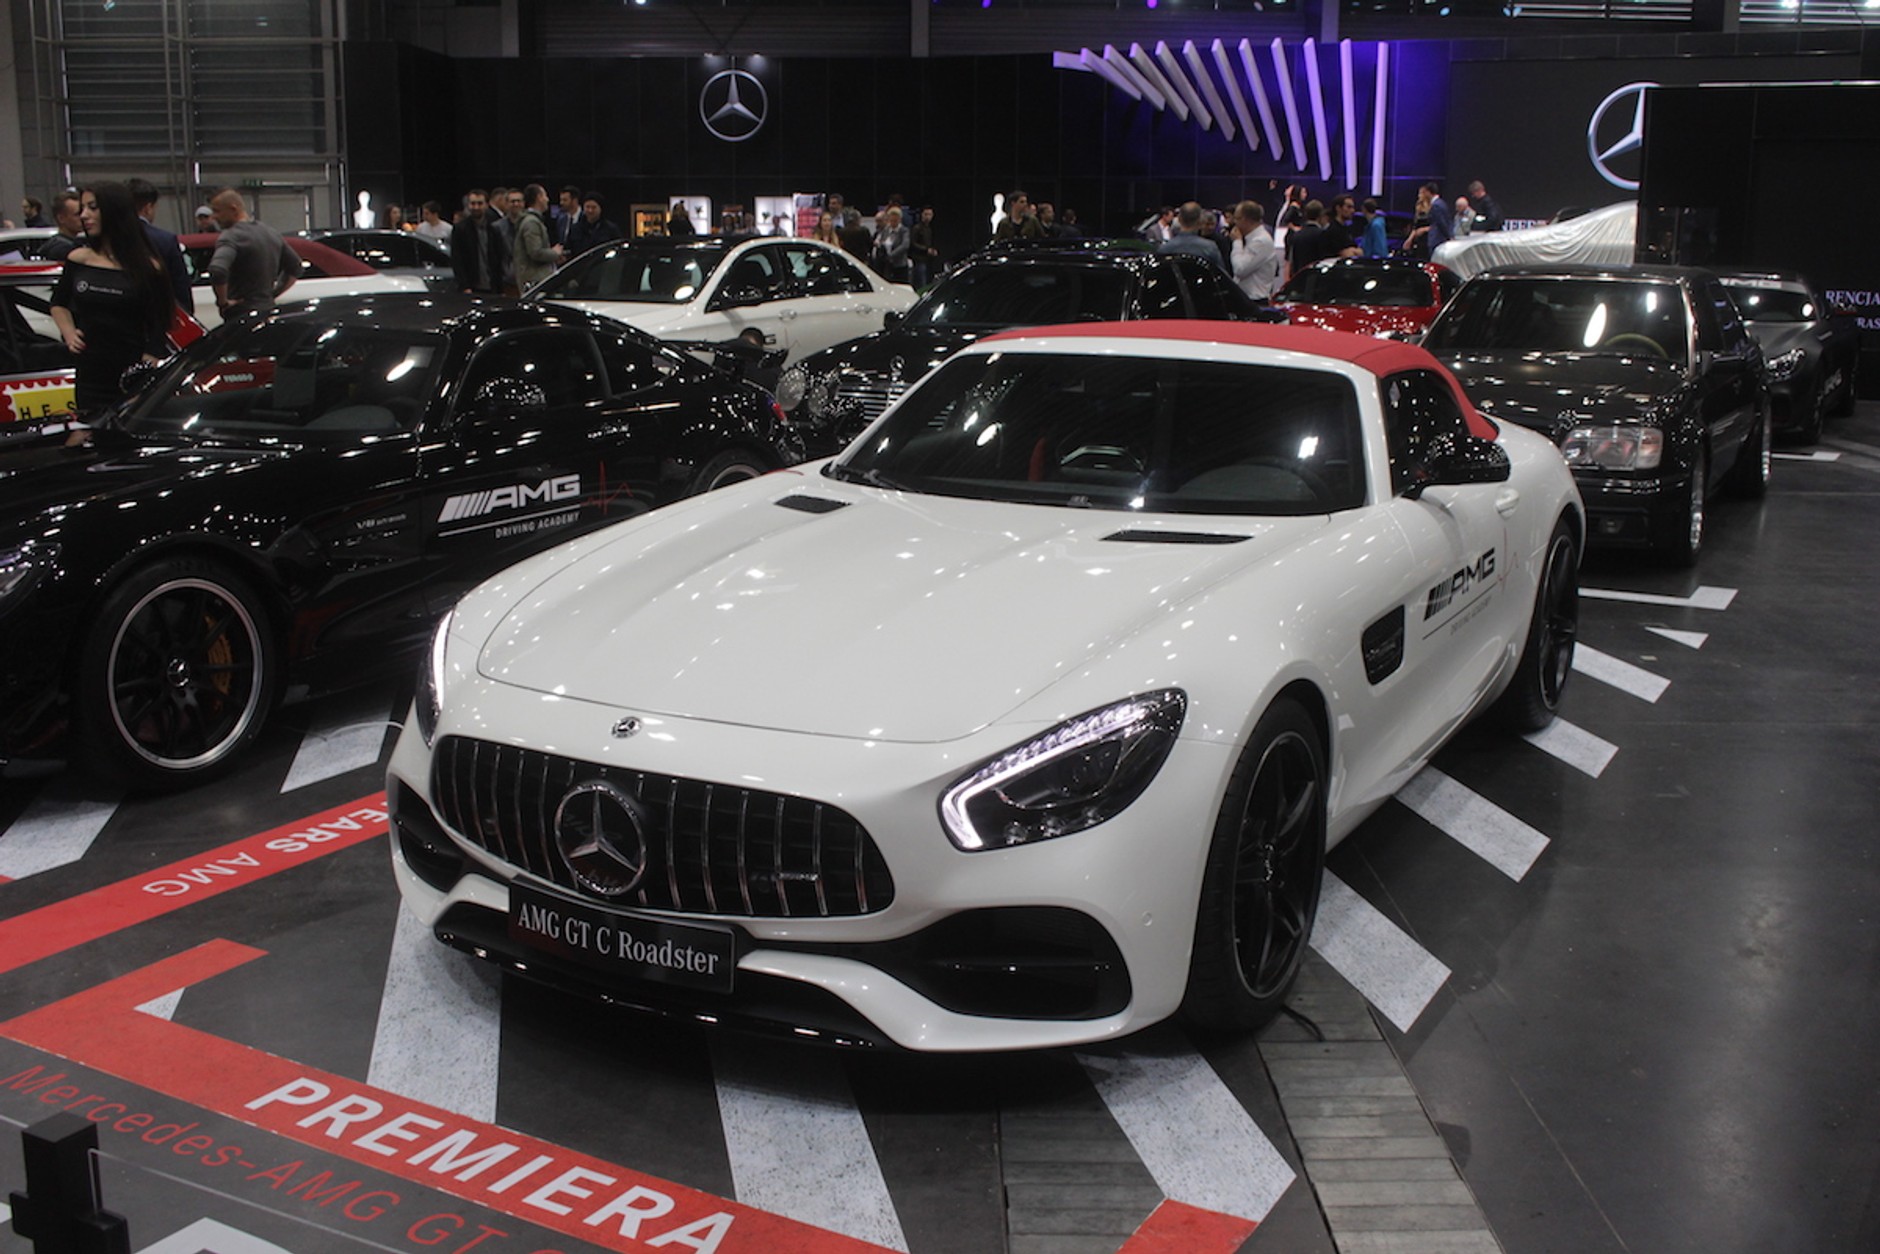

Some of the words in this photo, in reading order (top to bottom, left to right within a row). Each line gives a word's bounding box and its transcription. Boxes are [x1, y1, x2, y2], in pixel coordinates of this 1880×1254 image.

[1825, 289, 1880, 306] RENCJA
[1855, 316, 1880, 329] RAS
[484, 473, 581, 514] AMG
[495, 521, 535, 539] DRIVING
[538, 511, 580, 530] ACADEMY
[265, 805, 389, 853] EARS
[142, 851, 261, 896] AMG
[518, 902, 560, 939] AMG
[565, 916, 592, 949] GT
[596, 926, 611, 955] C
[618, 929, 719, 975] Roadster
[0, 1064, 400, 1222] Mercedes-AMG
[406, 1212, 510, 1254] GT
[243, 1076, 736, 1254] PREMIERA
